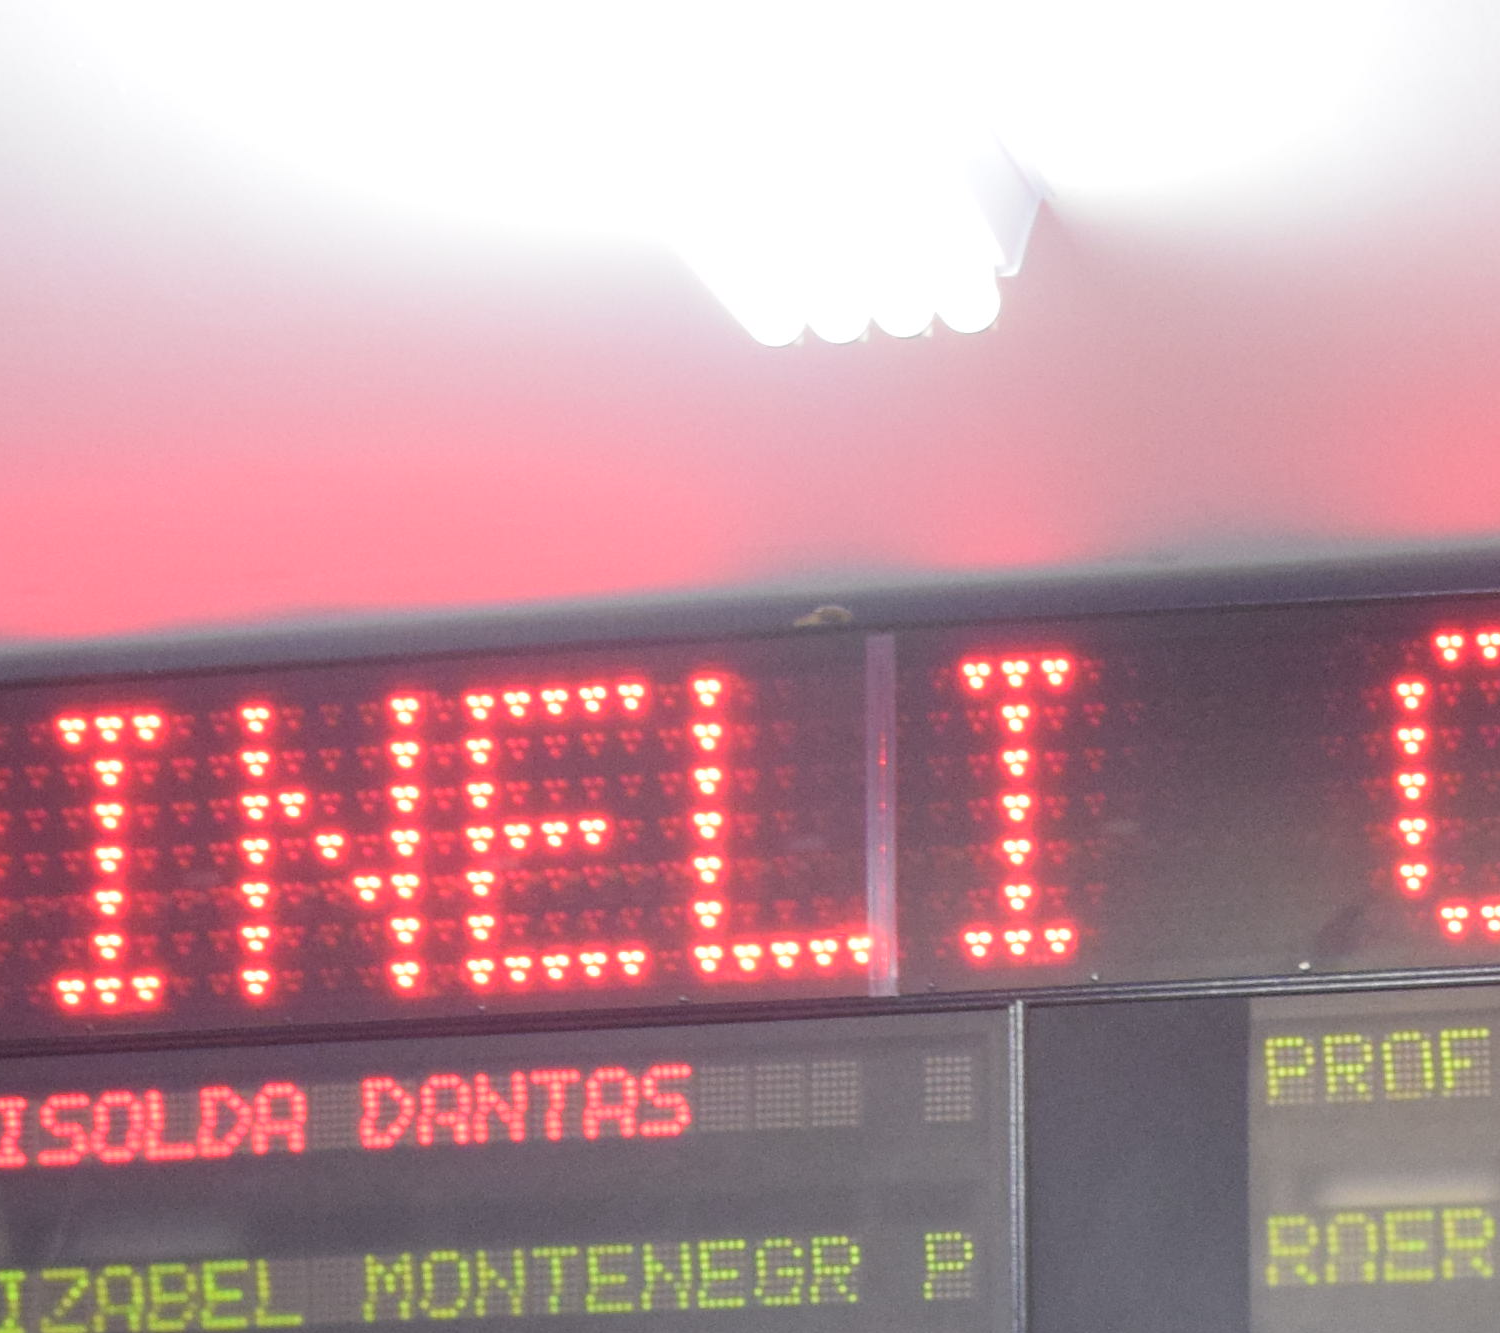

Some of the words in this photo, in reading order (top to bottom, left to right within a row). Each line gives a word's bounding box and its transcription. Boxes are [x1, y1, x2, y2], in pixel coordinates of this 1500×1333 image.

[356, 1061, 693, 1151] DANTAS
[361, 1235, 862, 1324] MONTENEGR
[923, 1231, 976, 1301] P
